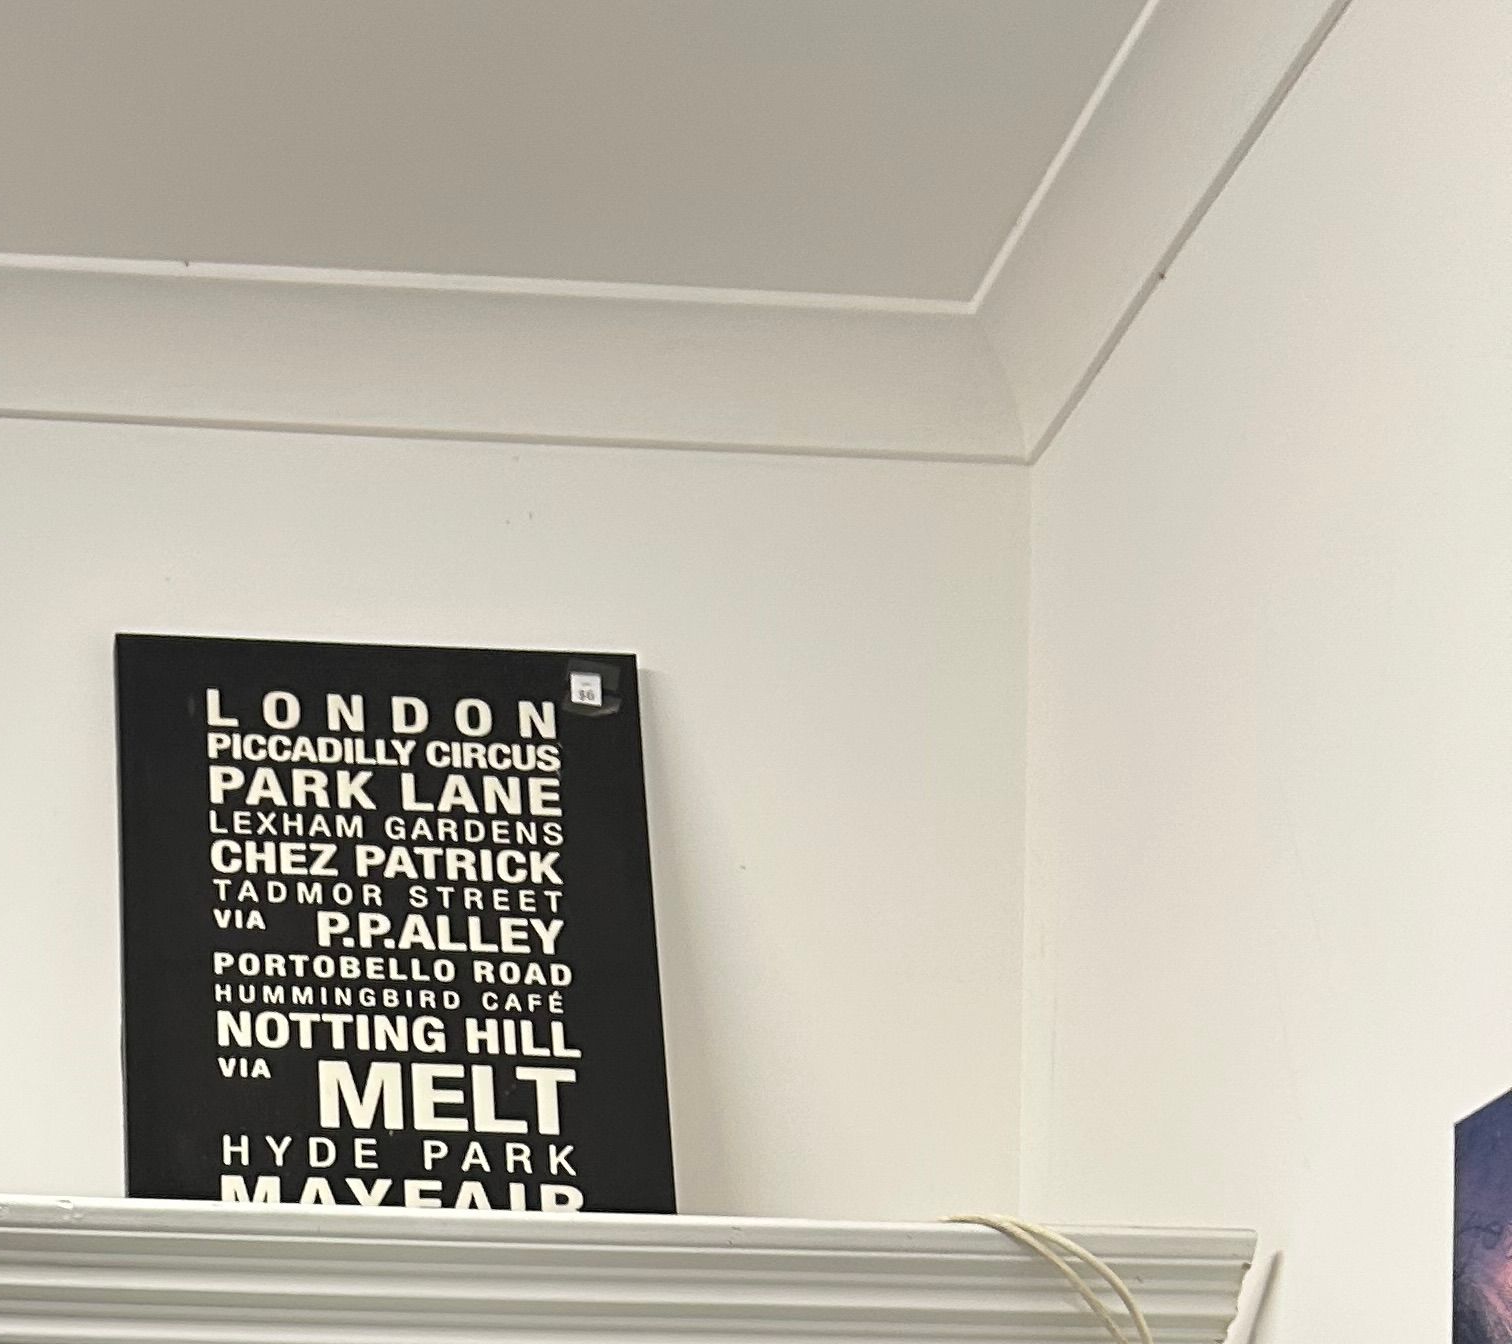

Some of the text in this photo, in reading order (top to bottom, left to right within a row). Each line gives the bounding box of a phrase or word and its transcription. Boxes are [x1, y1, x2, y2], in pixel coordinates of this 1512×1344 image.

[206, 688, 557, 739] LONDON
[207, 733, 561, 771] PICCADILLY CIRCUS
[209, 765, 562, 817] PARK LANE
[210, 810, 564, 845] LEXHAM GARDENS
[211, 839, 562, 885] CHEZ PATRICK
[213, 878, 562, 912] TADMOR STREET
[213, 909, 265, 930] VIA
[213, 952, 572, 987] PORTOBELLO ROAD
[214, 983, 564, 1014] HUMMINGBIRD CAFÉ
[217, 1010, 581, 1058] NOTTING HILL
[218, 1057, 576, 1135] VIA MELT
[222, 1134, 576, 1177] HYDE PARK
